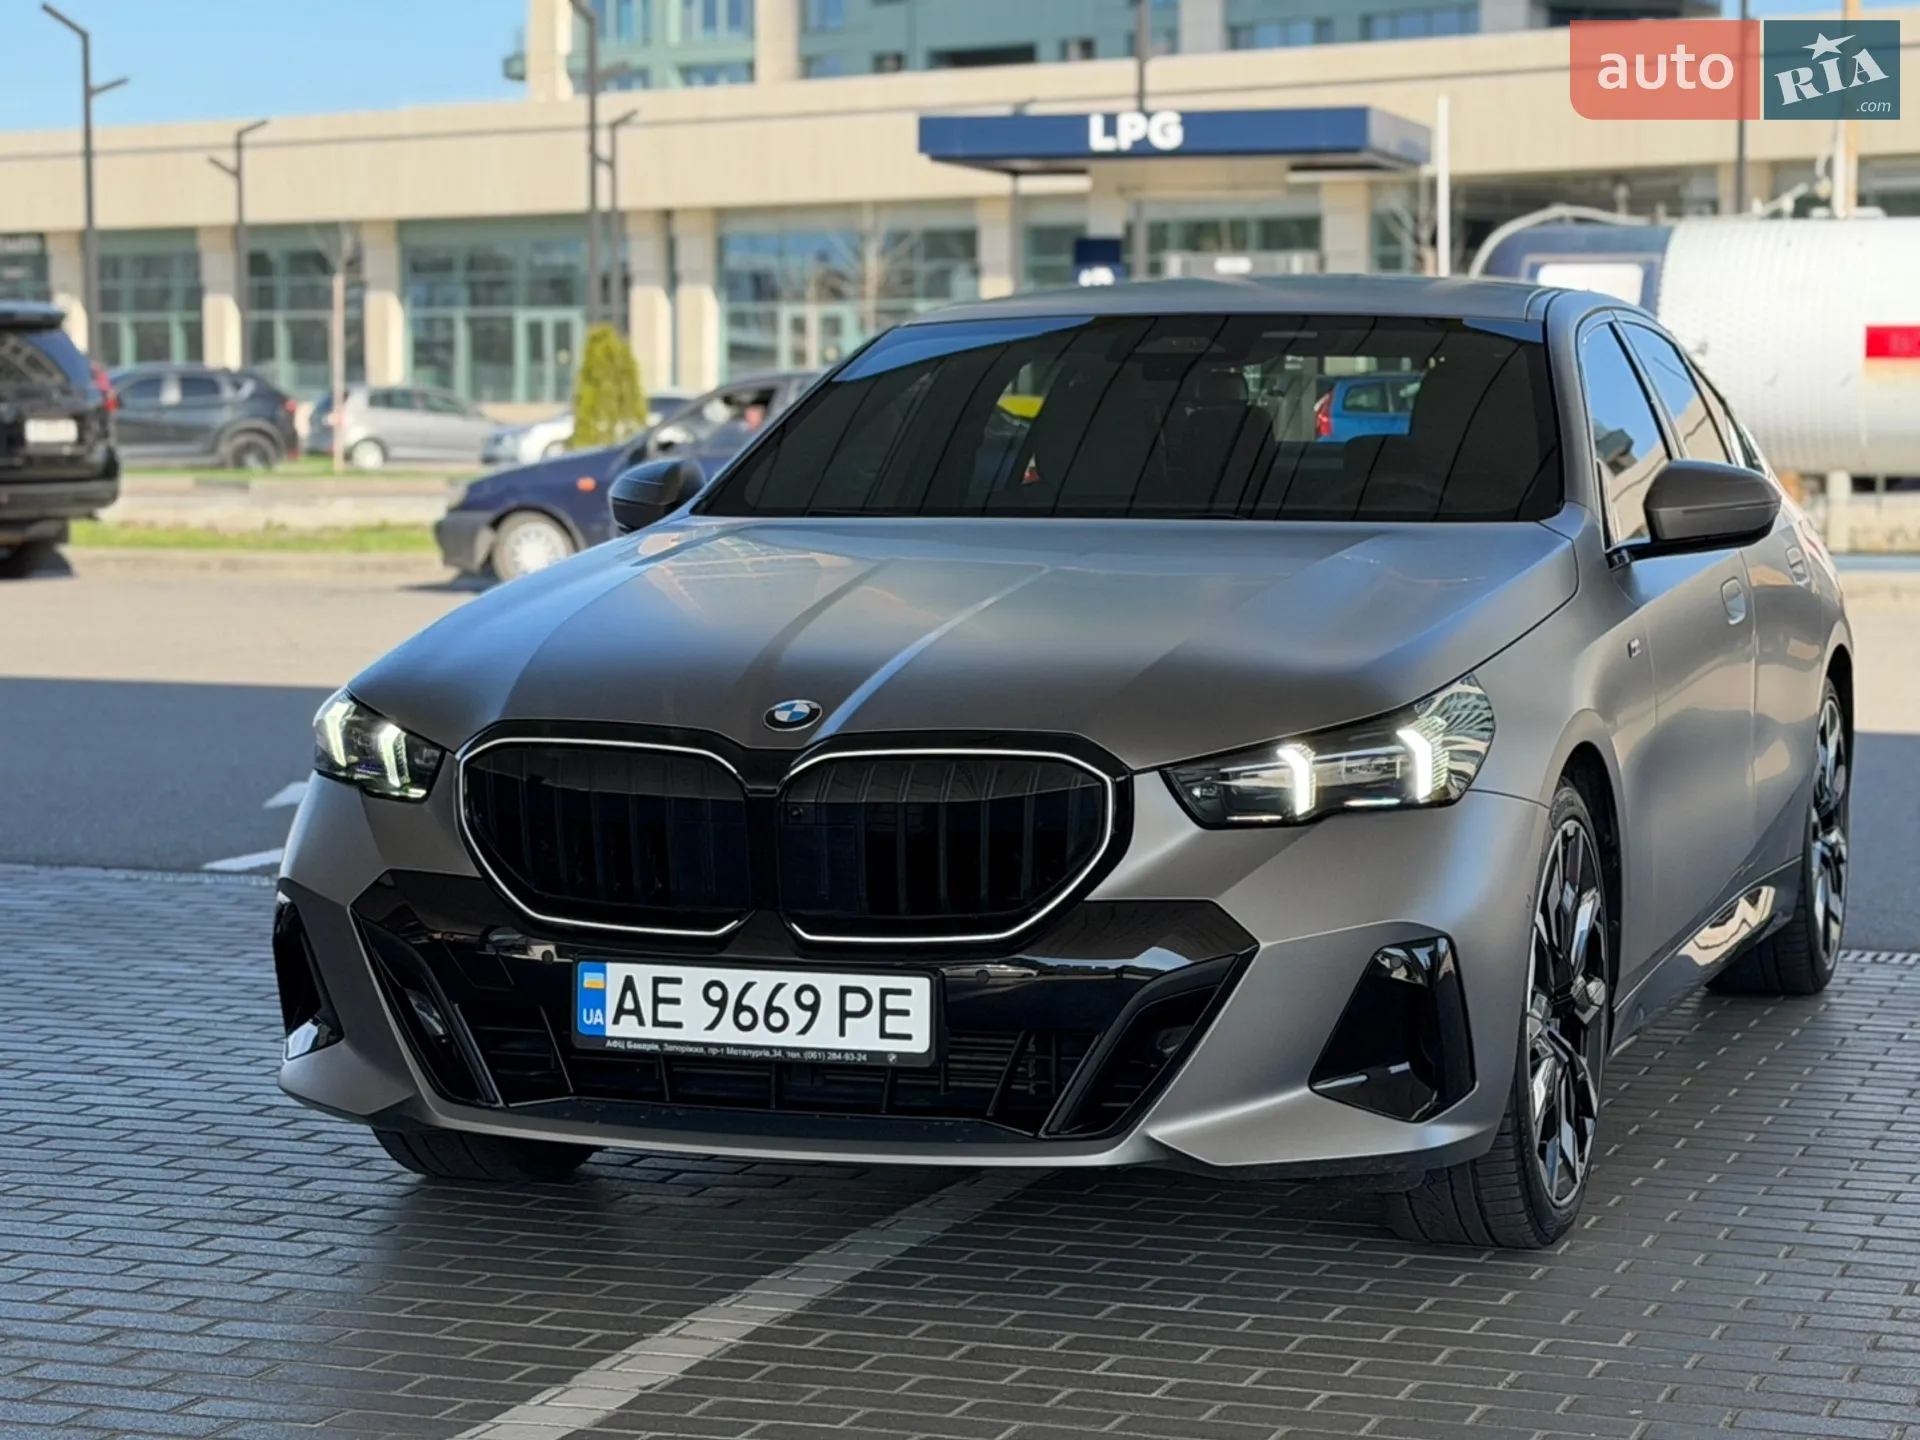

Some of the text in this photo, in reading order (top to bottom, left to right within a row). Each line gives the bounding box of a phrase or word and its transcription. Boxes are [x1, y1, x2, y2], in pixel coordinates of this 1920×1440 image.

[1089, 110, 1184, 151] LPG
[583, 1008, 604, 1025] UA
[611, 974, 913, 1041] AE 9669 PE
